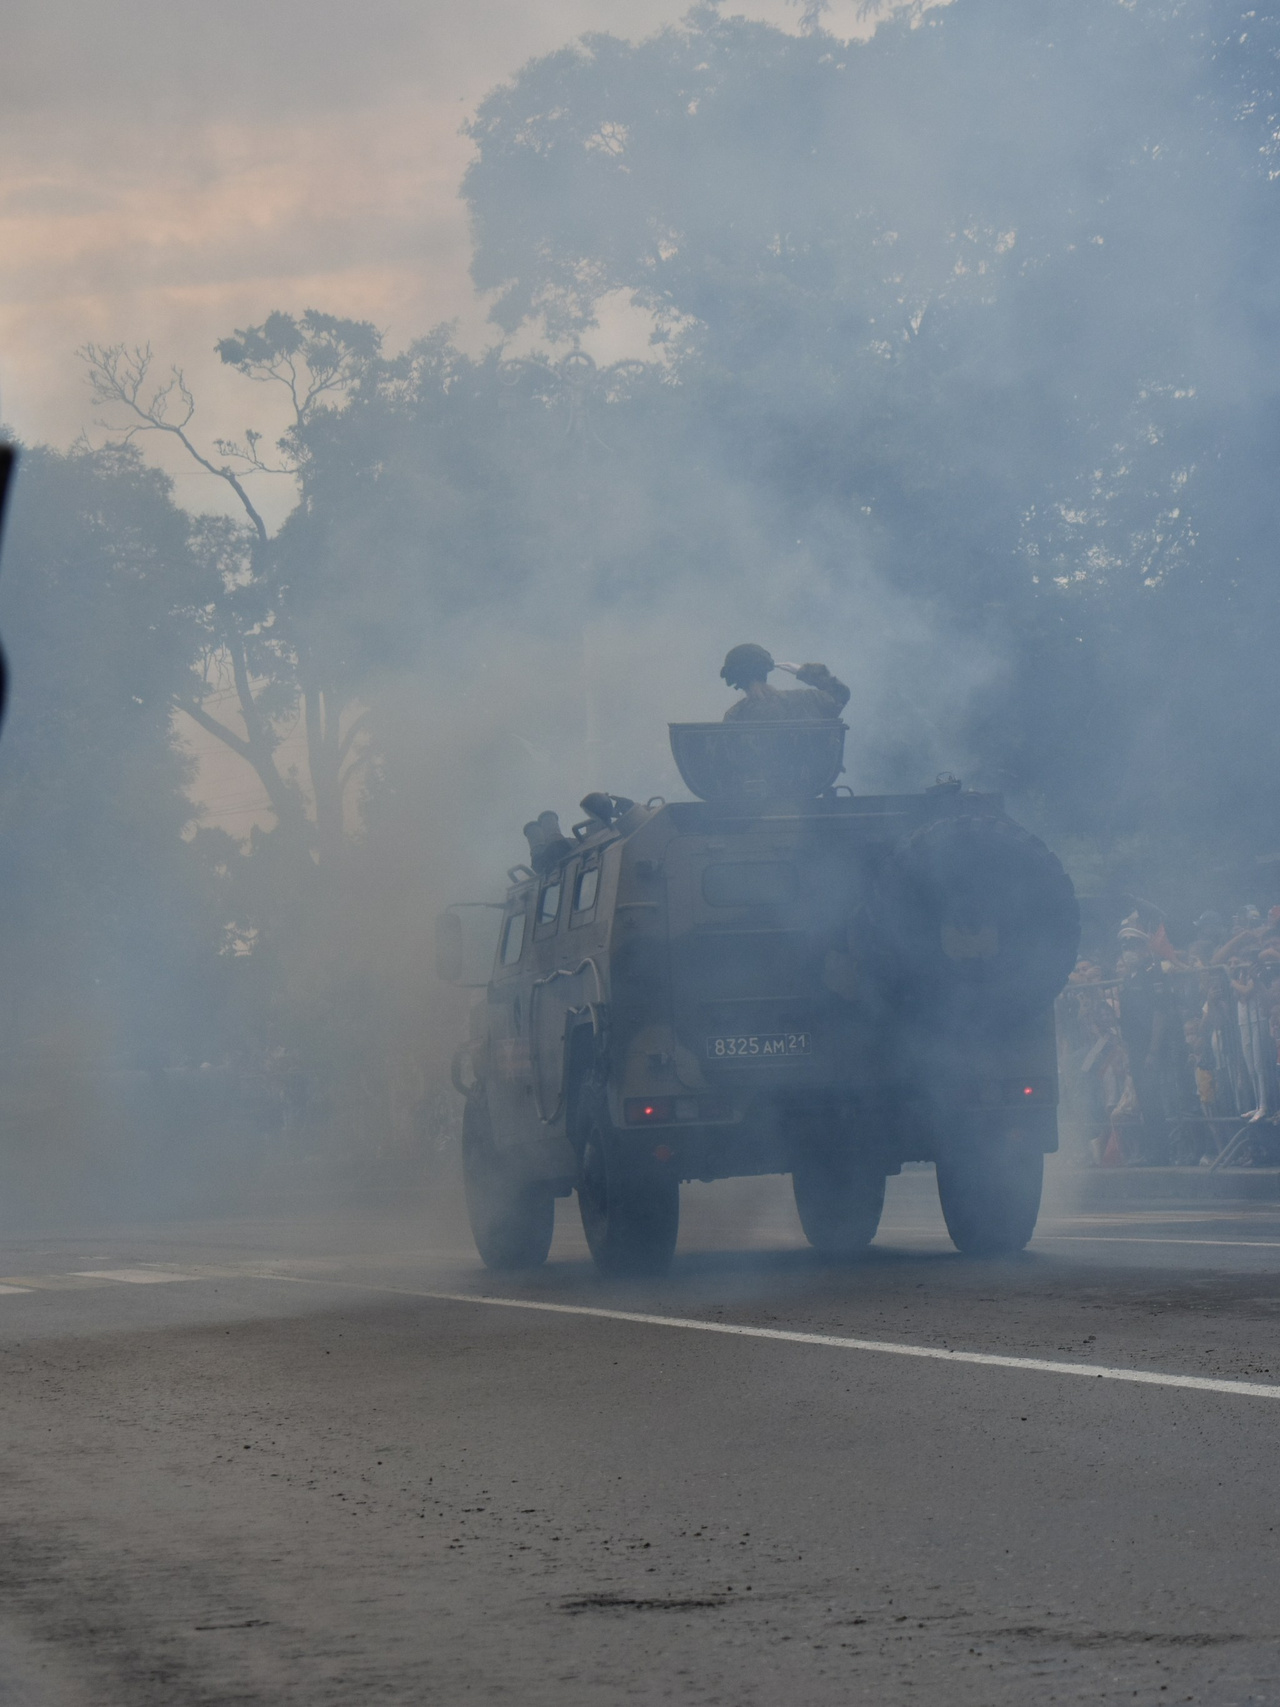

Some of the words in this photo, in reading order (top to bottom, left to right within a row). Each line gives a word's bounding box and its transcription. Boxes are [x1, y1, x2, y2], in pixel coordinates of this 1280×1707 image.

[715, 1037, 760, 1056] 8325
[763, 1040, 785, 1054] АМ
[788, 1034, 805, 1048] 21
